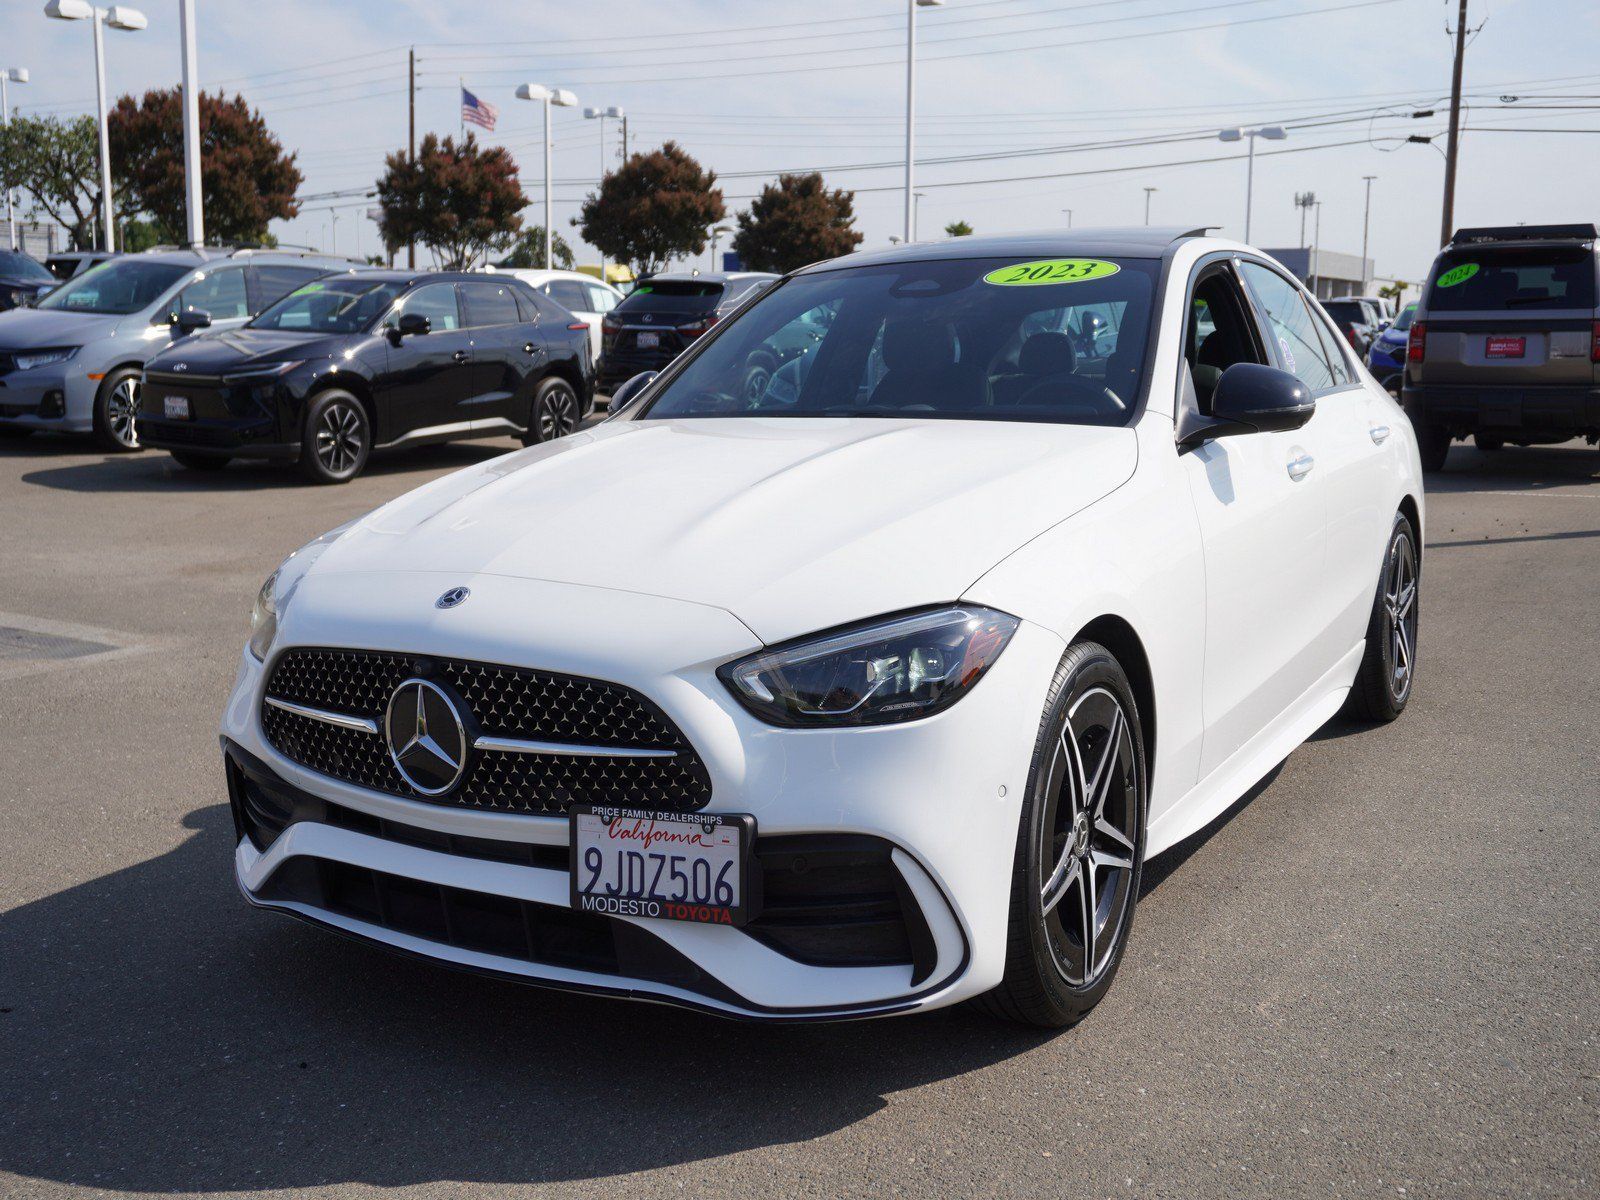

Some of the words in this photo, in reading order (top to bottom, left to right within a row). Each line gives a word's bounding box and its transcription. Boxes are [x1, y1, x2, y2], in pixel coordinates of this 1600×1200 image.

[1004, 262, 1098, 283] 2023
[1443, 265, 1471, 285] 2024
[591, 806, 620, 817] PRICE
[621, 809, 655, 820] FAMILY
[656, 812, 723, 825] DEALERSHIPS
[608, 816, 714, 850] California
[584, 846, 734, 907] 9JDZ506
[581, 895, 660, 917] MODESTO
[663, 903, 733, 924] TOYOTA
